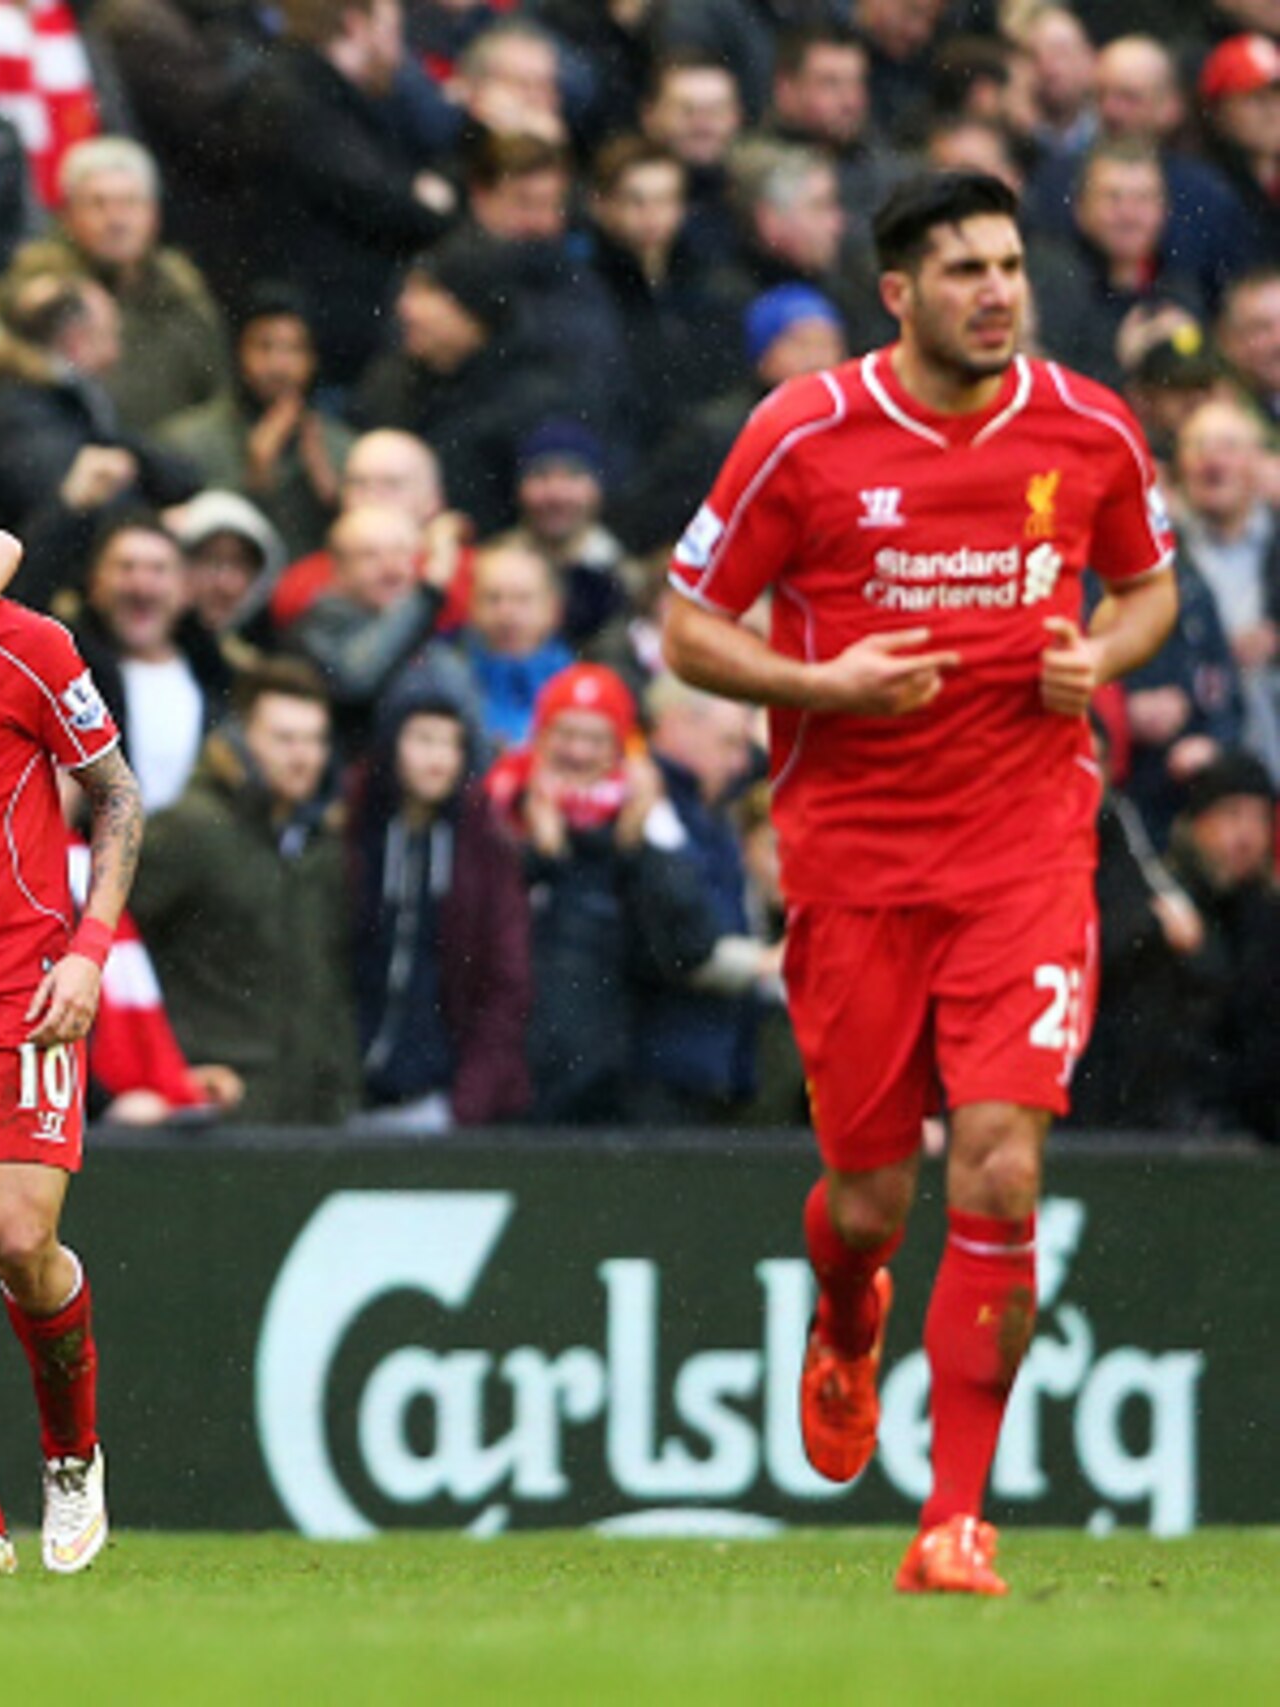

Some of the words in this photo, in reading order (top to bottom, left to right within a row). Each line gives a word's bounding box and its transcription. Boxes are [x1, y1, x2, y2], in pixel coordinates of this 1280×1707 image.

[874, 547, 1019, 578] Standard
[863, 580, 1017, 611] Chartered
[1029, 963, 1081, 1048] 2
[17, 1043, 72, 1109] 10
